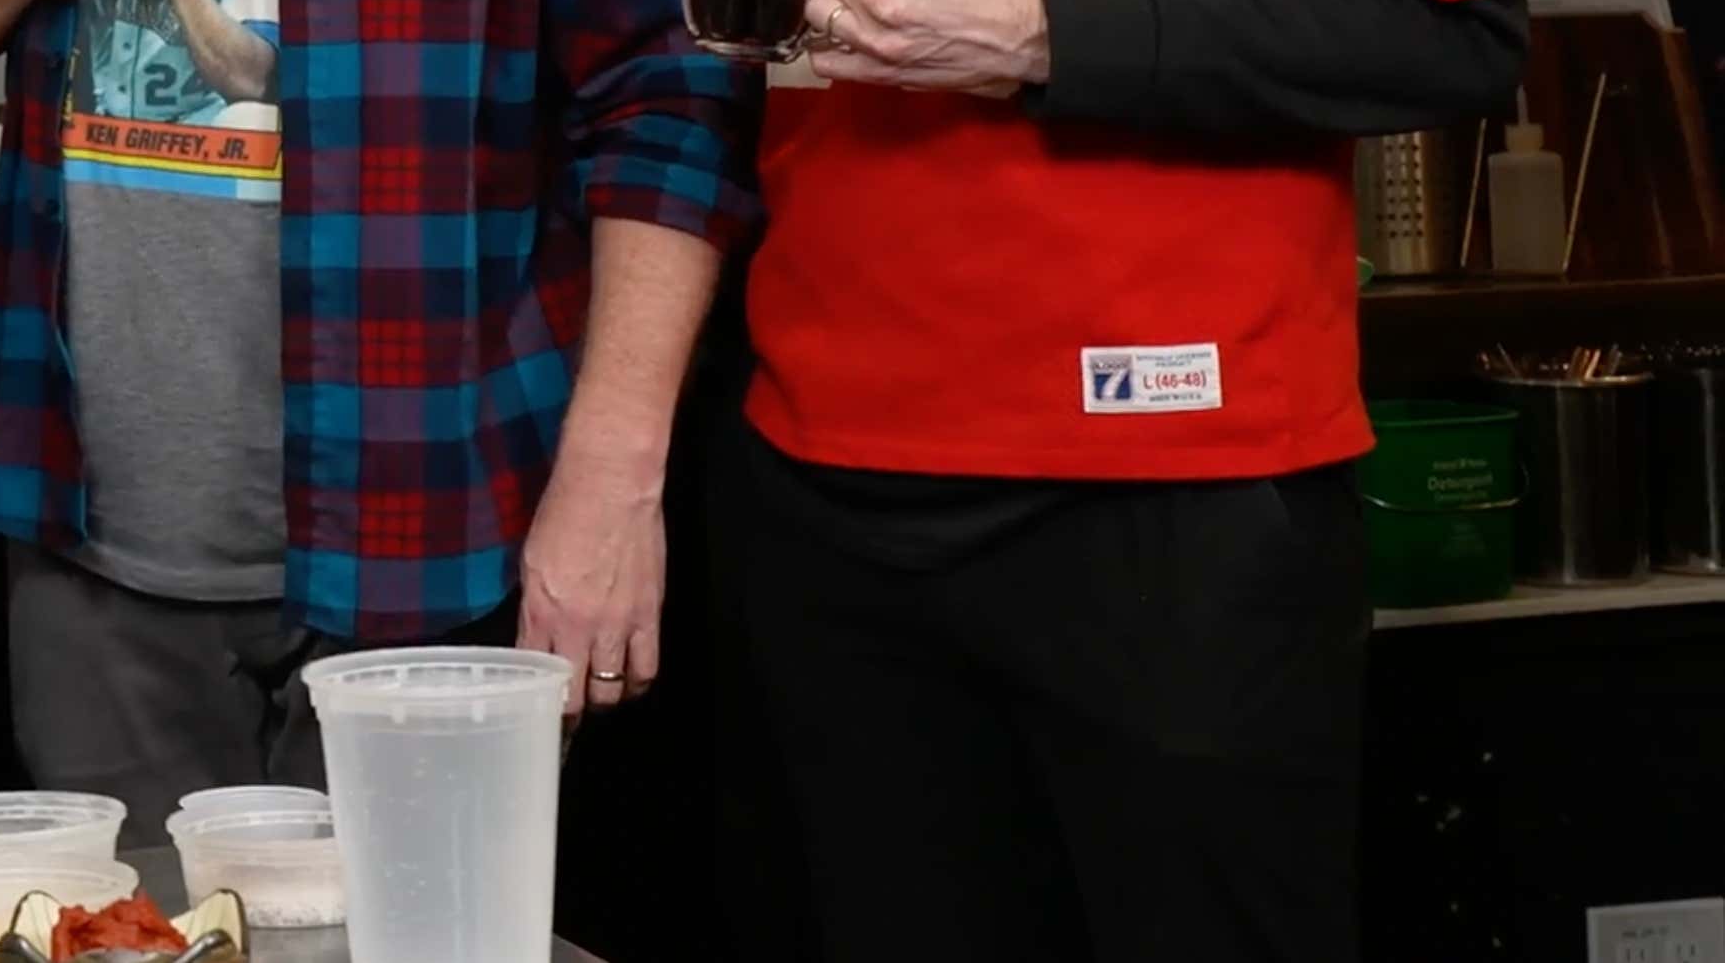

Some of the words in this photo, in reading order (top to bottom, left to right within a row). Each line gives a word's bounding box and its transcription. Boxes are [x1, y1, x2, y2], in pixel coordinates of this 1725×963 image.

[86, 122, 119, 146] KEN
[126, 127, 209, 158] GRIFFEY,
[218, 138, 250, 161] JR.
[1143, 374, 1154, 390] L
